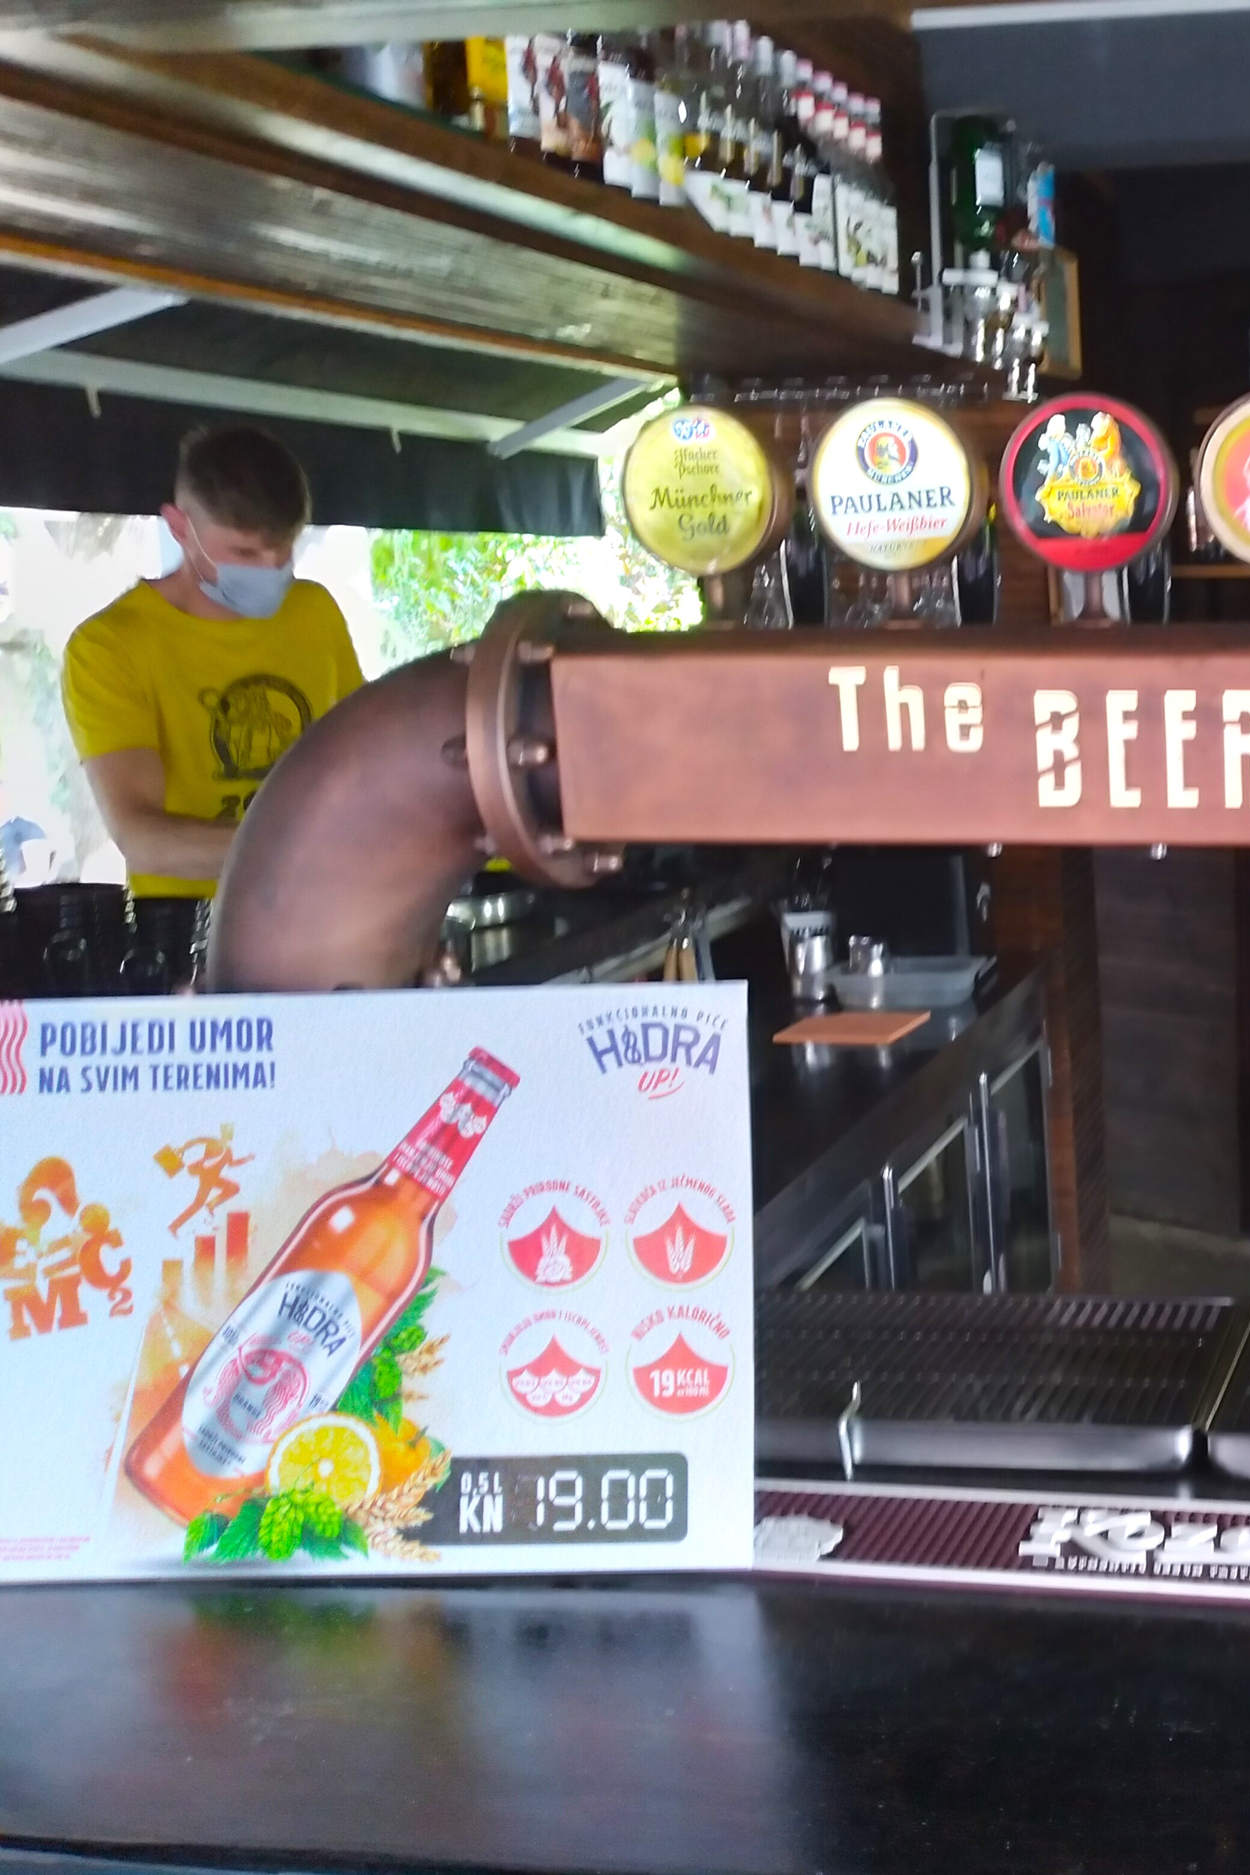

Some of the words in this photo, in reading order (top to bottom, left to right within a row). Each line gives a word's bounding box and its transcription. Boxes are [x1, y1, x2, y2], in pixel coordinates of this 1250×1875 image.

[649, 484, 753, 511] Münchner
[830, 485, 956, 516] PAULANER
[1057, 486, 1120, 502] PAULANER
[678, 513, 730, 541] Gold
[846, 514, 948, 540] Hefe-Weißbier
[828, 665, 985, 752] The
[40, 1018, 176, 1057] POBIJEDI
[189, 1017, 274, 1054] UMOR
[38, 1066, 71, 1094] NA
[80, 1064, 140, 1093] SVIM
[150, 1061, 276, 1091] TERENIMA!
[637, 1067, 681, 1093] UP!
[667, 1304, 731, 1340] KALORIČNO
[649, 1368, 675, 1398] 19
[676, 1368, 709, 1386] KCAL
[460, 1471, 489, 1497] 0,5
[493, 1471, 503, 1494] L
[459, 1494, 504, 1534] KN
[535, 1468, 674, 1532] 19.00
